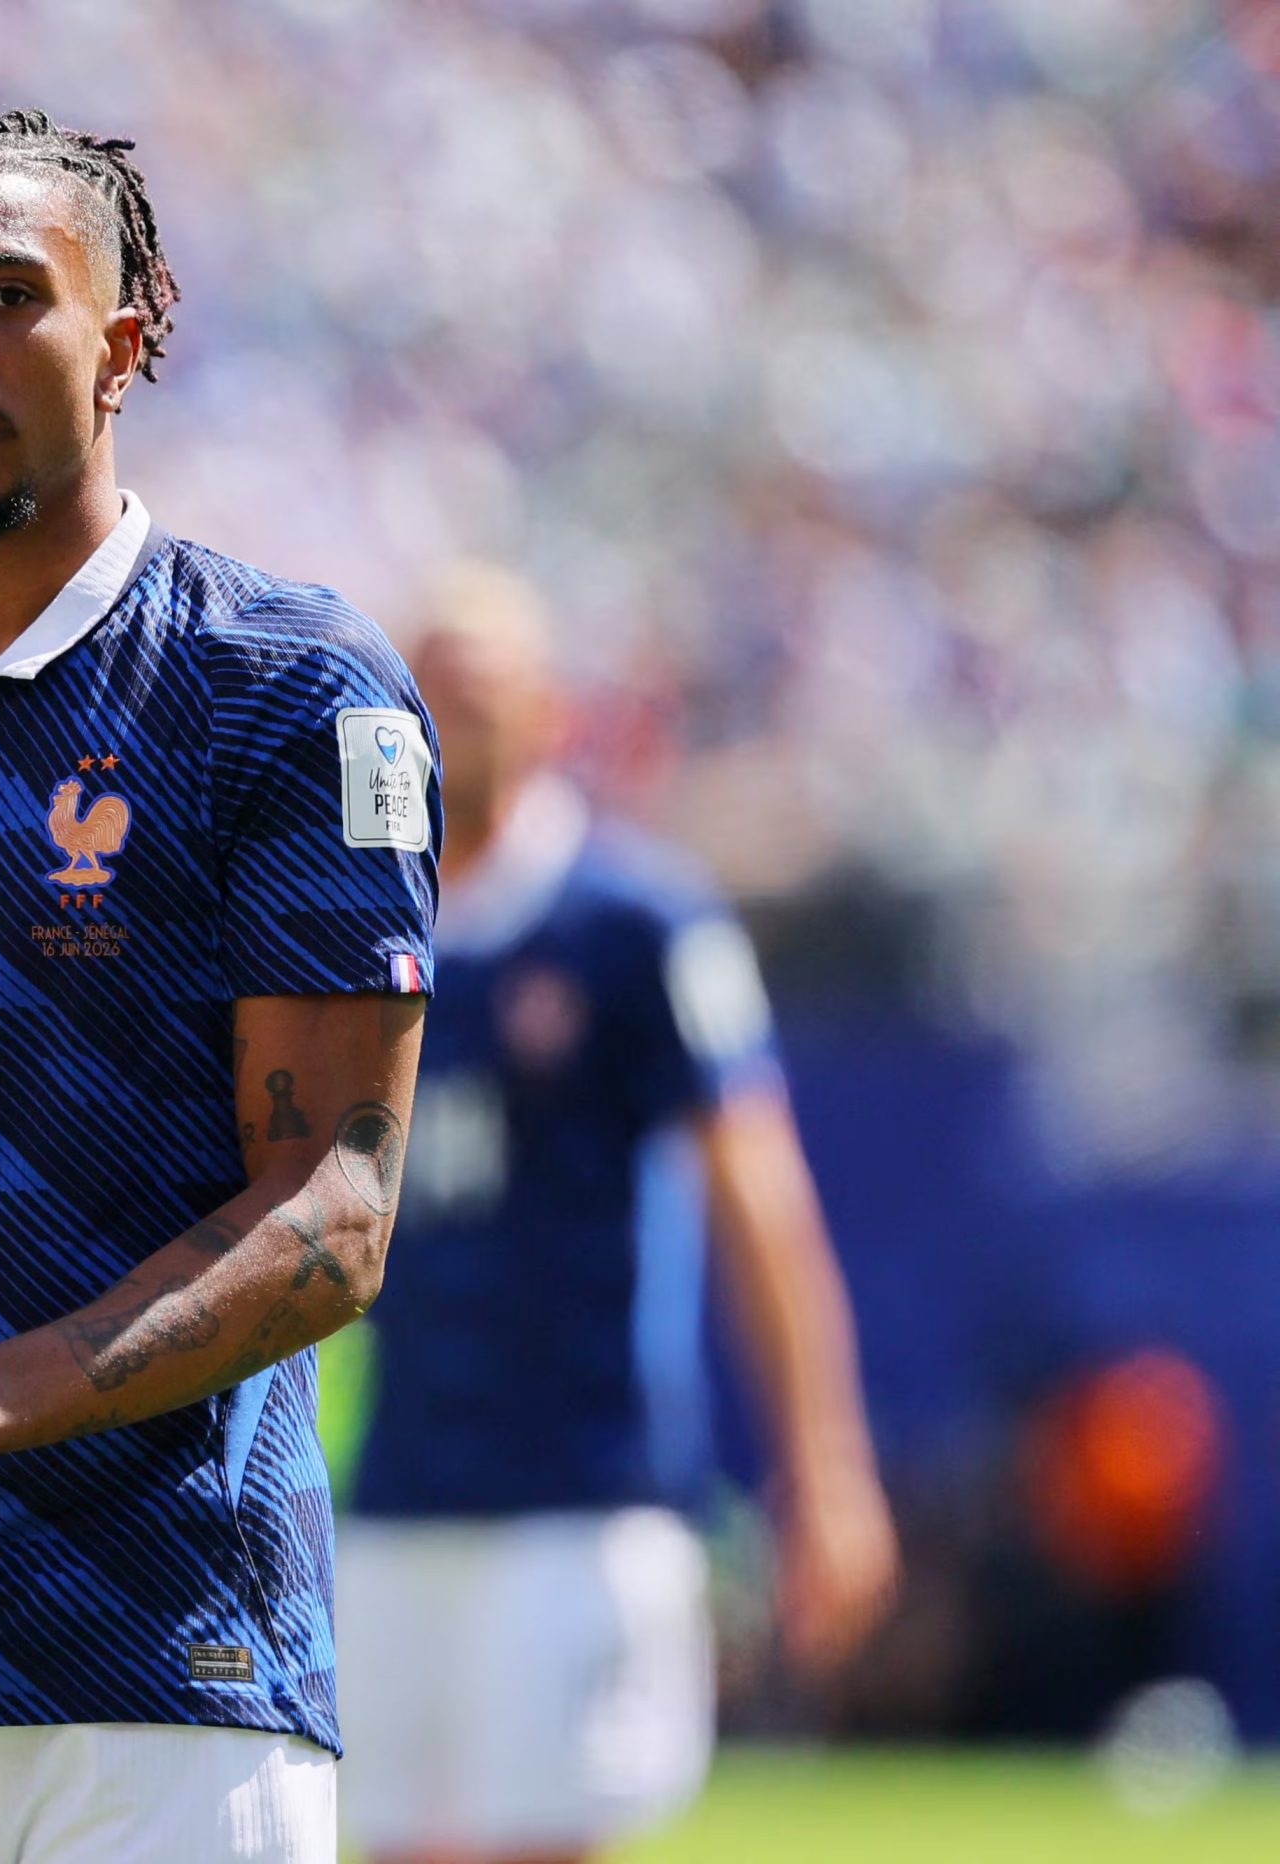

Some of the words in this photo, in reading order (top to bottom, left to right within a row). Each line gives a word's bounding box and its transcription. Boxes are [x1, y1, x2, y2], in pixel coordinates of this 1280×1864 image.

[374, 793, 408, 818] PEACE
[385, 820, 401, 832] FIFA
[31, 925, 72, 940] FRANCE
[83, 922, 130, 940] SÉNÉGAL
[42, 942, 55, 957] 16
[84, 941, 121, 957] 2026
